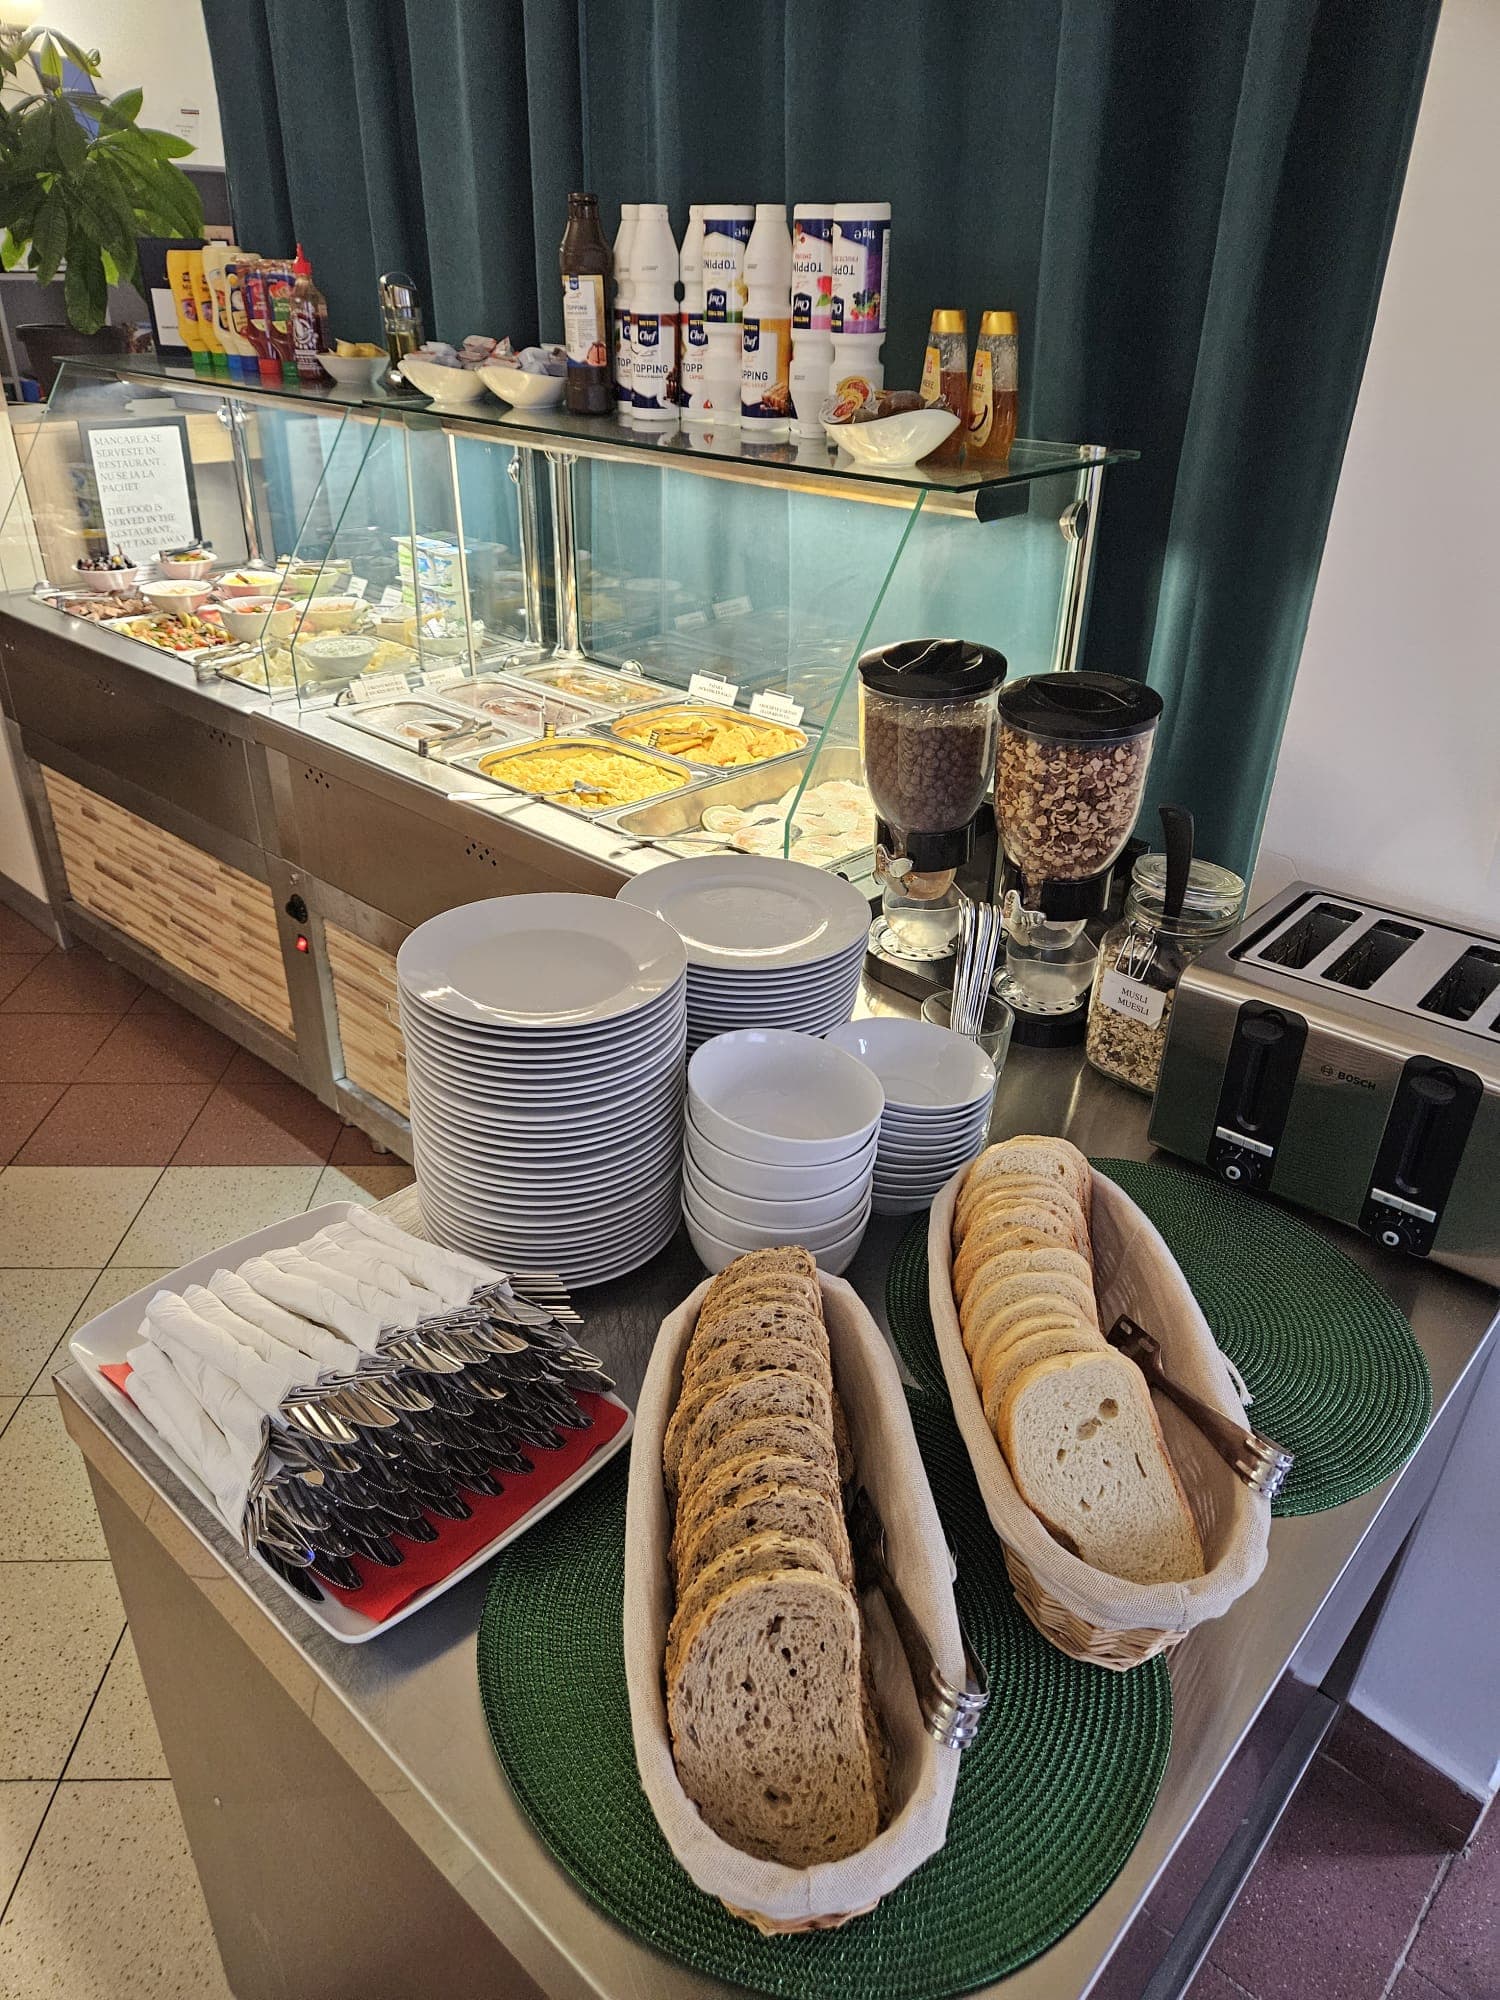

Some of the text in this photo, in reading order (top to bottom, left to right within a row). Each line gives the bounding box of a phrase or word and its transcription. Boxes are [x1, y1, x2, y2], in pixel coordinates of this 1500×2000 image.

[640, 330, 657, 343] Chef
[633, 363, 669, 374] TOPPING
[94, 434, 149, 446] MANCAREA
[96, 447, 144, 458] SERVESTE
[102, 482, 139, 493] PACHET
[106, 503, 163, 516] THE FOOD IS
[108, 516, 145, 527] SERVED
[146, 515, 157, 523] IN
[133, 537, 156, 548] TAKE
[161, 534, 187, 545] AWAY
[1121, 987, 1148, 1004] MUSLI
[1117, 996, 1149, 1016] MUESLI
[1338, 1071, 1376, 1090] BOSCH
